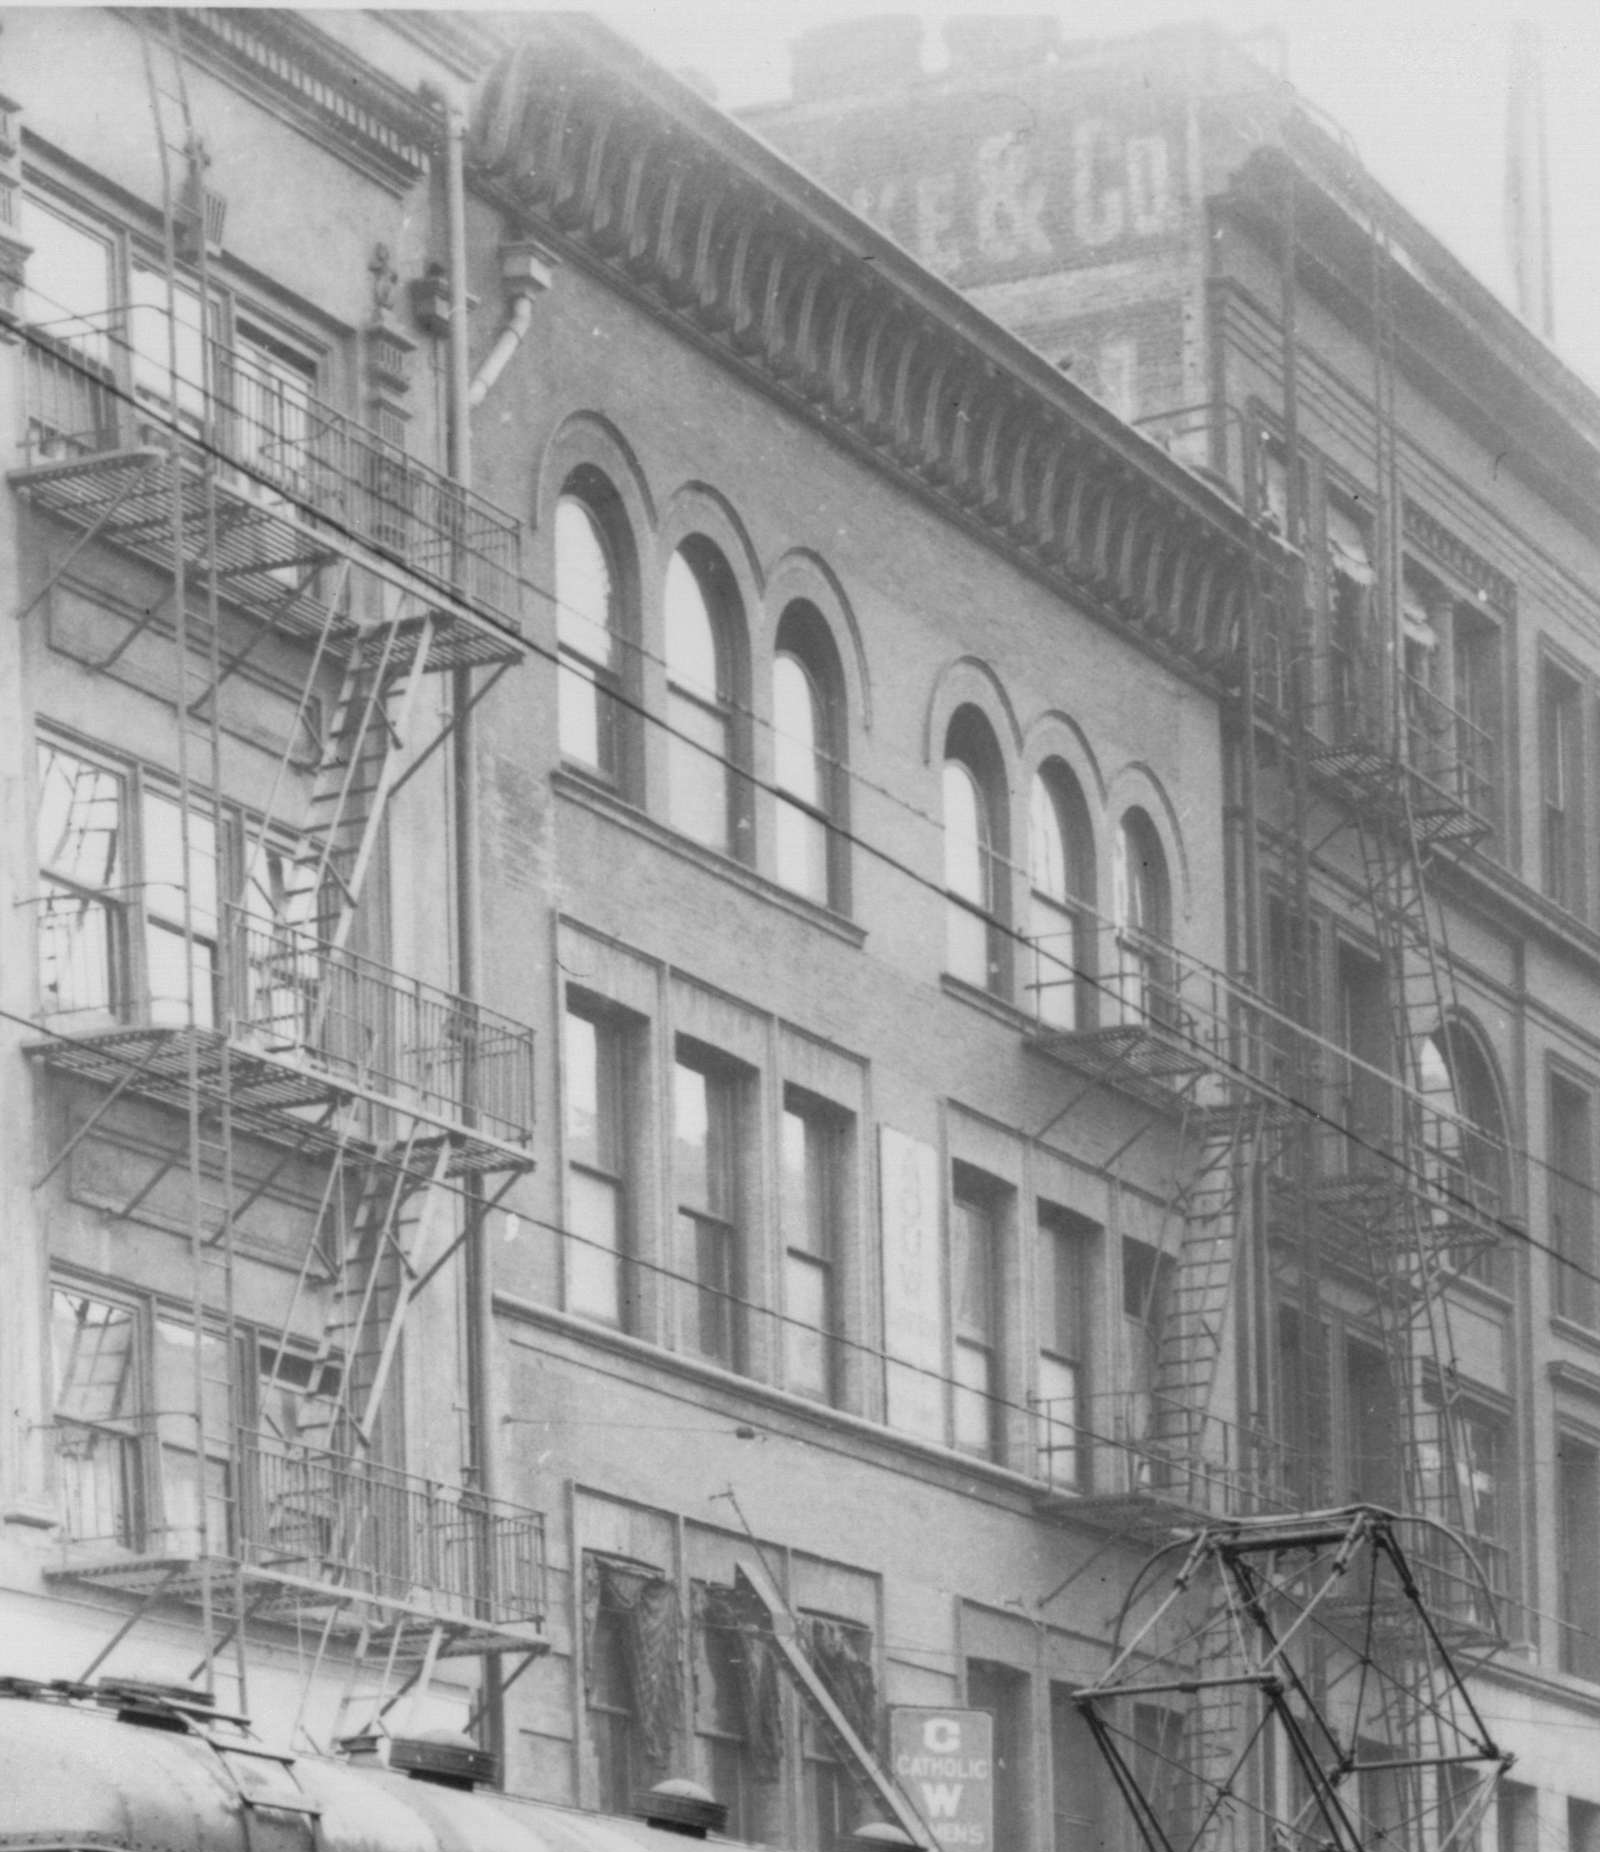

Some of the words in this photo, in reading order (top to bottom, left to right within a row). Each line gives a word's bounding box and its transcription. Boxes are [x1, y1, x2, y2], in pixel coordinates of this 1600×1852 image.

[922, 1717, 962, 1754] C
[896, 1753, 988, 1780] CATHOLIC
[920, 1782, 965, 1819] W
[929, 1822, 986, 1845] MEN'S
